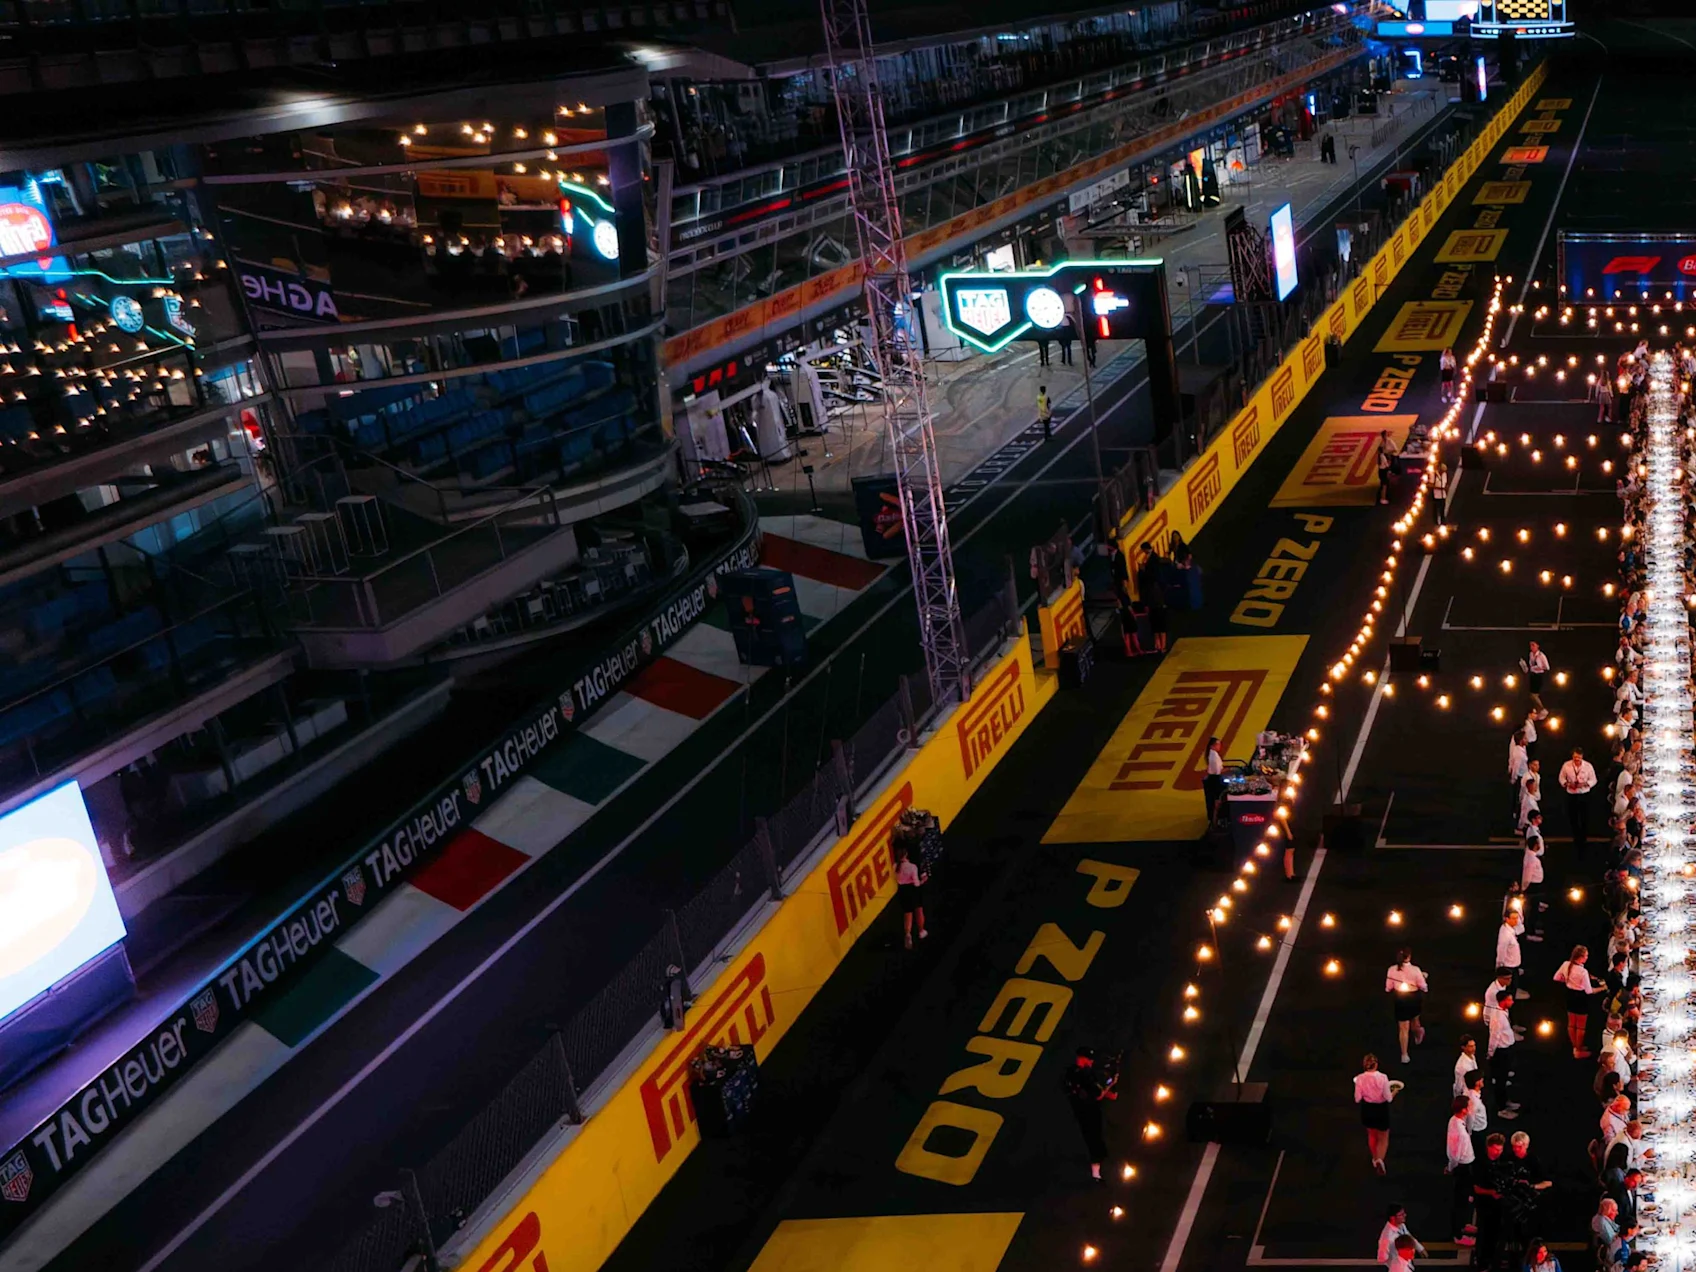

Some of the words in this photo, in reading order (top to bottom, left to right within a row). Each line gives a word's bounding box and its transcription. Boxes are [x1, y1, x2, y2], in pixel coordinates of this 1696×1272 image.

[1270, 365, 1295, 422] PIRELLI
[1360, 366, 1418, 412] ZERO
[1232, 405, 1261, 470] PIRELLI
[1303, 430, 1393, 486] PIRELLI
[1187, 450, 1222, 525] PIRELLI
[1293, 513, 1335, 534] P
[1229, 537, 1321, 628] ZERO
[956, 658, 1025, 780] PIRELLI
[1108, 669, 1270, 791] PIRELLI
[1075, 858, 1141, 908] P
[894, 922, 1107, 1187] ZERO
[1, 1156, 26, 1178] TAG
